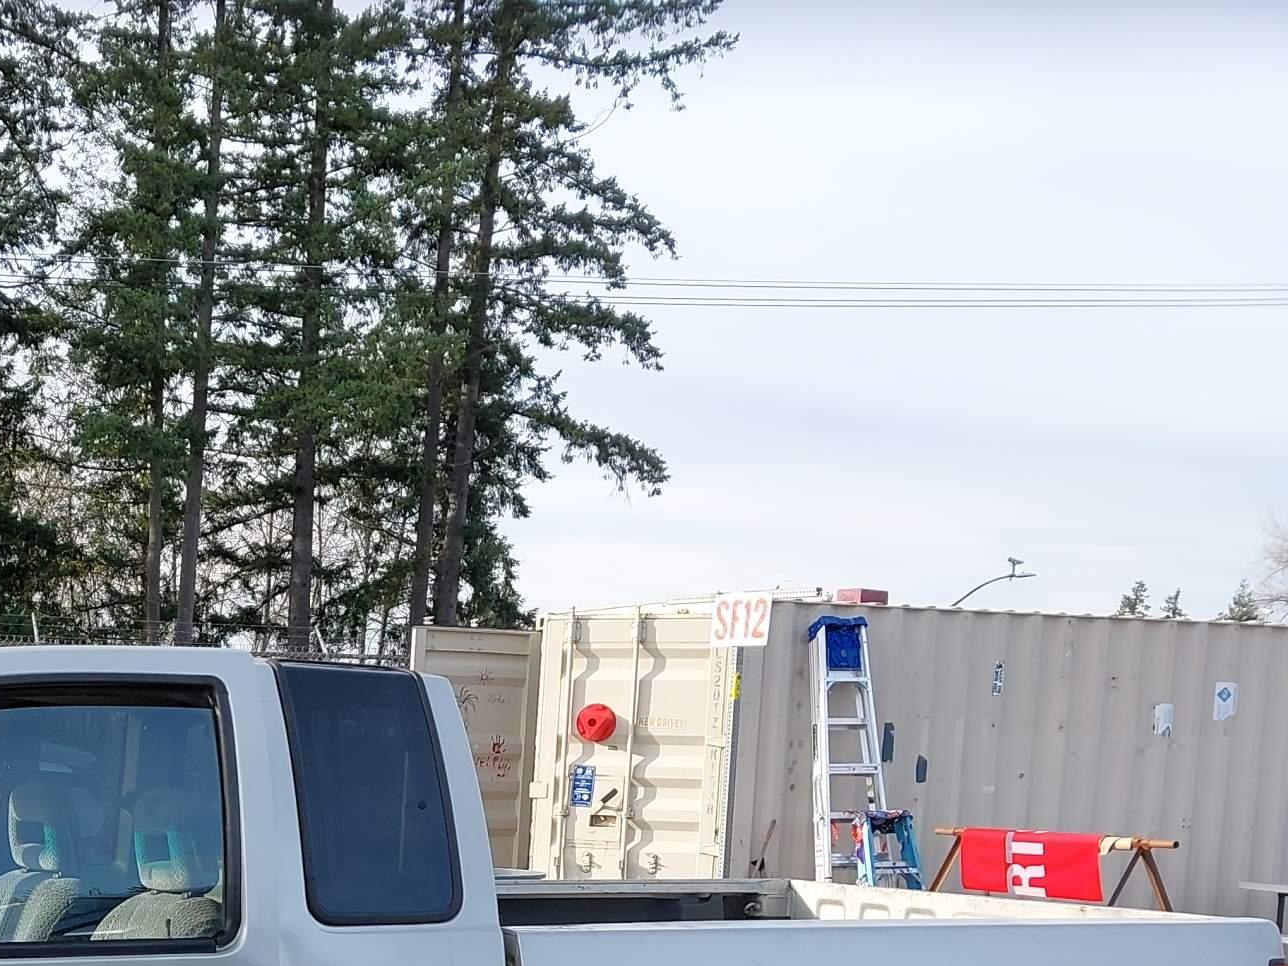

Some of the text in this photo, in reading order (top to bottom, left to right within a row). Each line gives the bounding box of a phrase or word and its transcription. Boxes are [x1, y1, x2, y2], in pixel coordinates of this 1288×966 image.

[713, 597, 769, 641] SF12
[638, 715, 656, 728] NEW
[1005, 830, 1047, 898] RT
